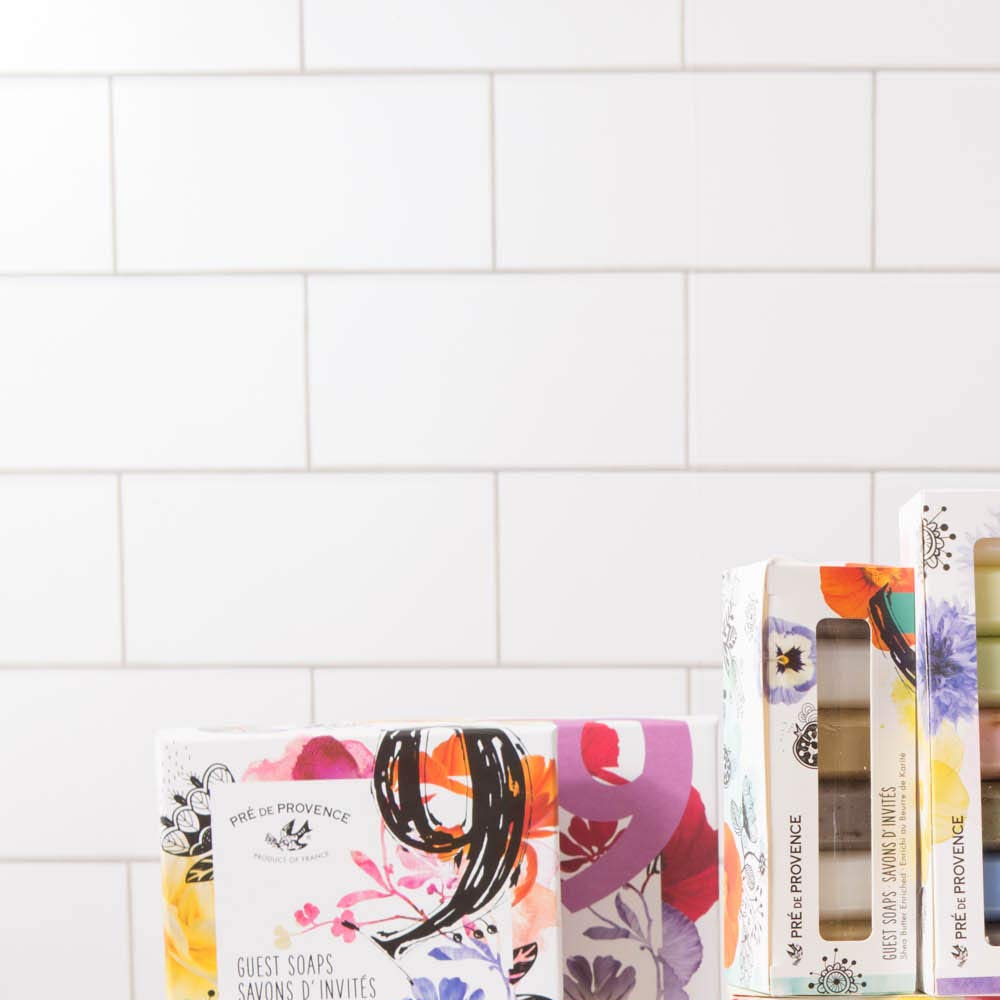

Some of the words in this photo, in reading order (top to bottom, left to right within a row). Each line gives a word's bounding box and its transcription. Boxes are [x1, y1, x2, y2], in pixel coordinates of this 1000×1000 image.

[229, 806, 256, 828] PRÉ
[259, 806, 274, 817] DE
[277, 803, 351, 824] PROVENCE
[371, 728, 531, 958] 9
[790, 815, 801, 892] PROVENCE
[952, 816, 965, 893] PROVENCE
[881, 843, 896, 882] SAVONS
[794, 897, 802, 908] DE
[882, 891, 896, 924] SOAPS
[957, 898, 965, 909] DE
[787, 912, 802, 938] PRÉ
[952, 913, 966, 939] PRÉ
[882, 930, 896, 960] GUEST
[238, 956, 279, 978] GUEST
[288, 954, 333, 976] SOAPS
